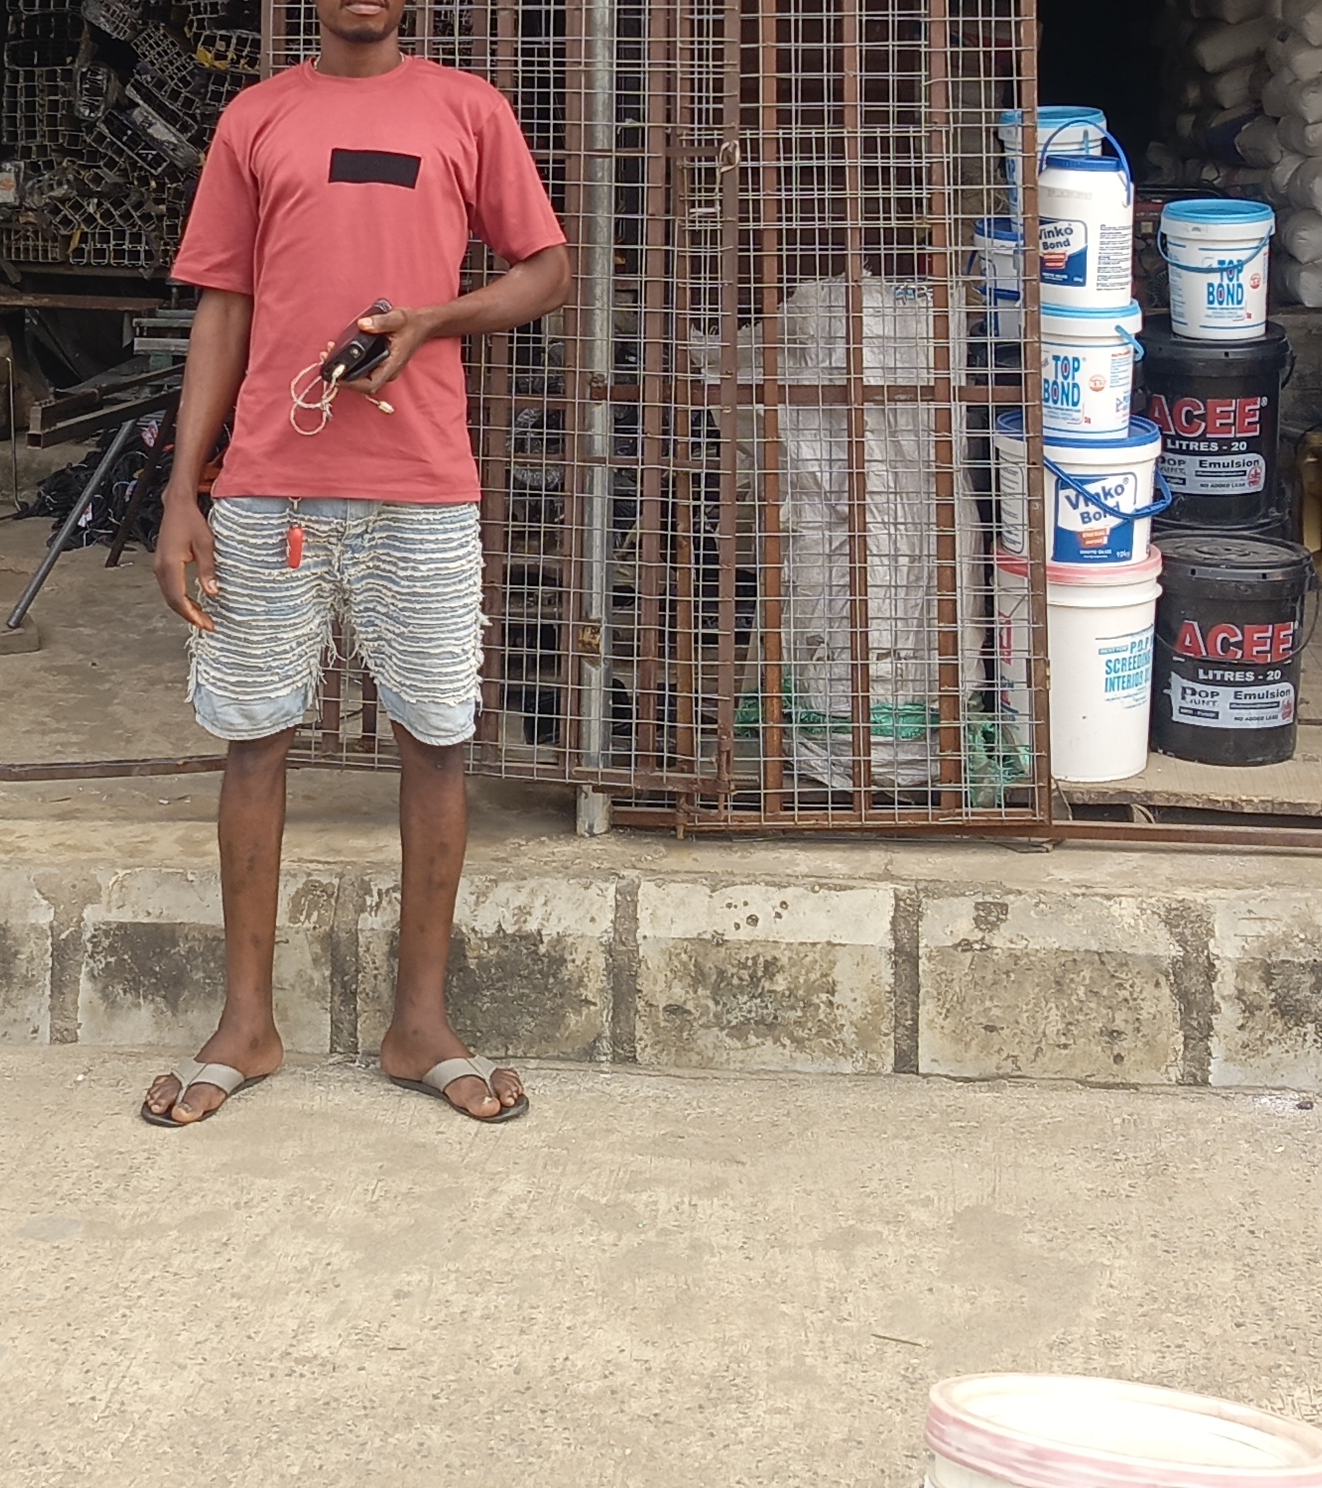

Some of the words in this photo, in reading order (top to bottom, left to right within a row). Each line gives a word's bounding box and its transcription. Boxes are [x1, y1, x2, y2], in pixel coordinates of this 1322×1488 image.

[1217, 259, 1244, 282] TOP
[1207, 282, 1244, 306] BOND
[1052, 354, 1081, 381] TOP
[1043, 377, 1081, 407] BOND
[1147, 394, 1261, 438] ACEE
[1167, 439, 1219, 451] LITRES
[1231, 441, 1247, 451] 20
[1199, 458, 1260, 469] Emulsion
[1064, 483, 1125, 511] Viko
[1079, 500, 1121, 524] Bod
[1175, 620, 1294, 662] ACEE
[1198, 669, 1255, 682] LITRES
[1266, 670, 1282, 680] 20
[1234, 689, 1291, 700] Emulsion
